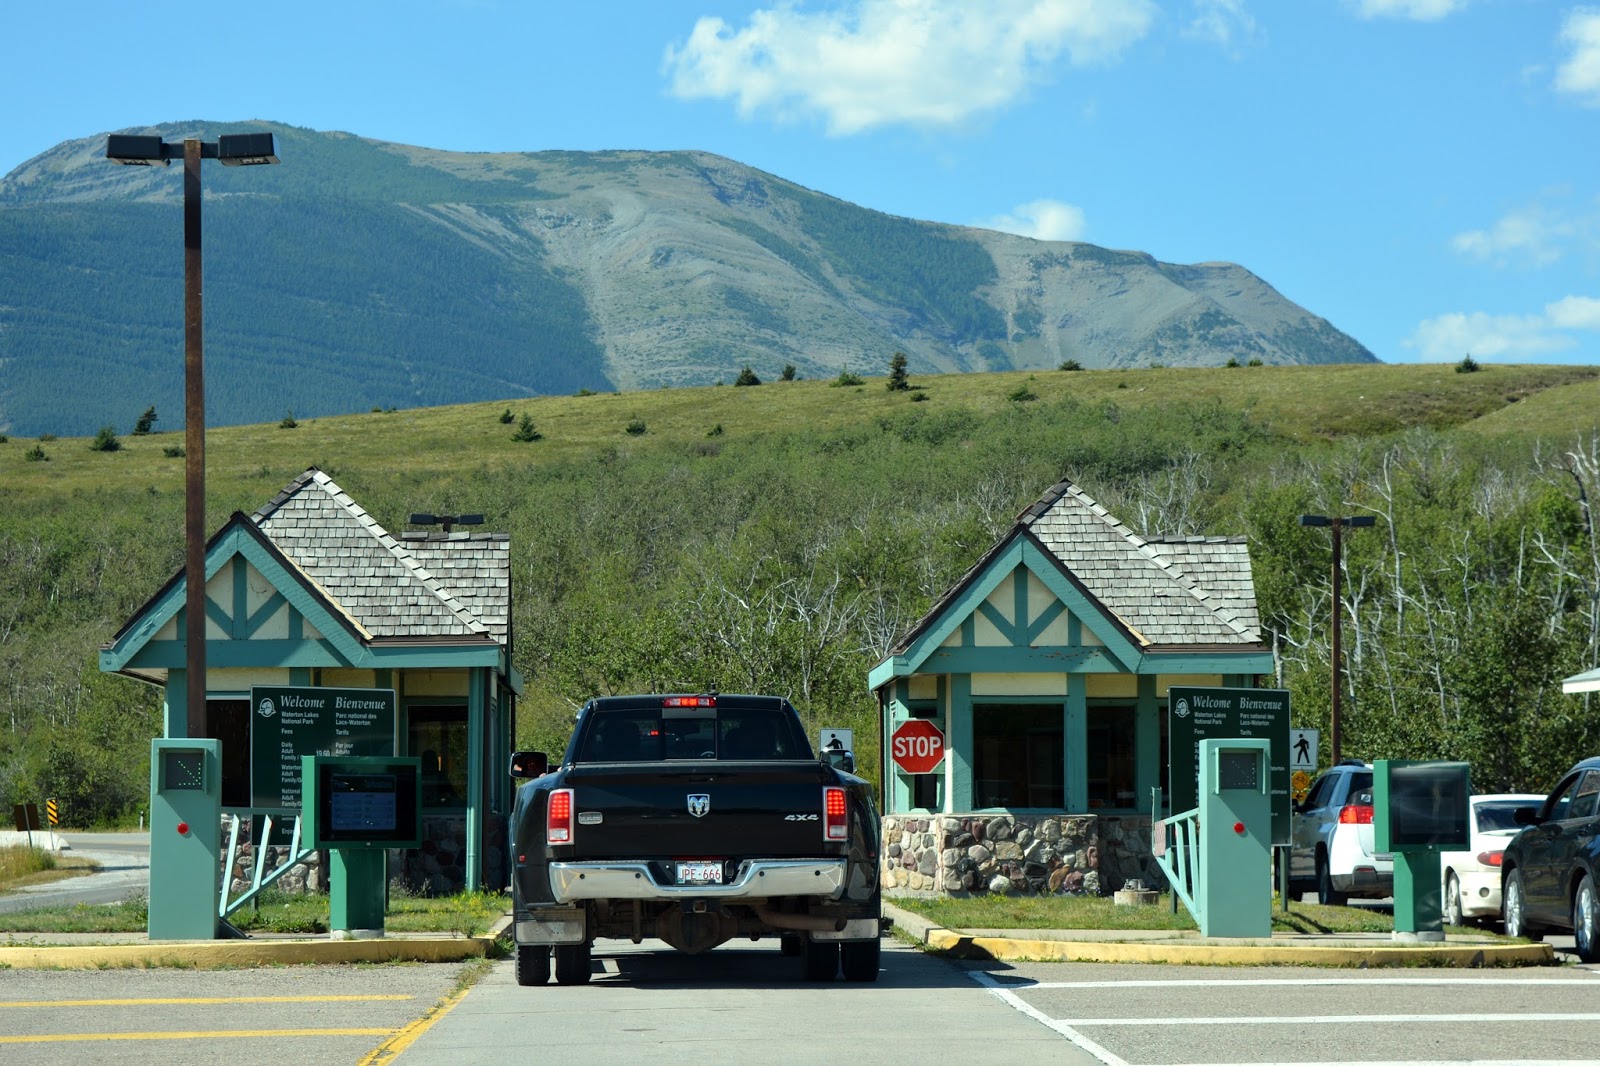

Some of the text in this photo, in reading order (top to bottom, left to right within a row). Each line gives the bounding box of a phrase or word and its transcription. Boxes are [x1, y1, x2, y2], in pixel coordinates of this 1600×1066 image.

[280, 695, 325, 708] Welcome
[335, 696, 386, 710] Bienvenue
[1193, 695, 1232, 708] Welcome
[1240, 696, 1283, 710] Bienvenue
[894, 736, 942, 758] STOP
